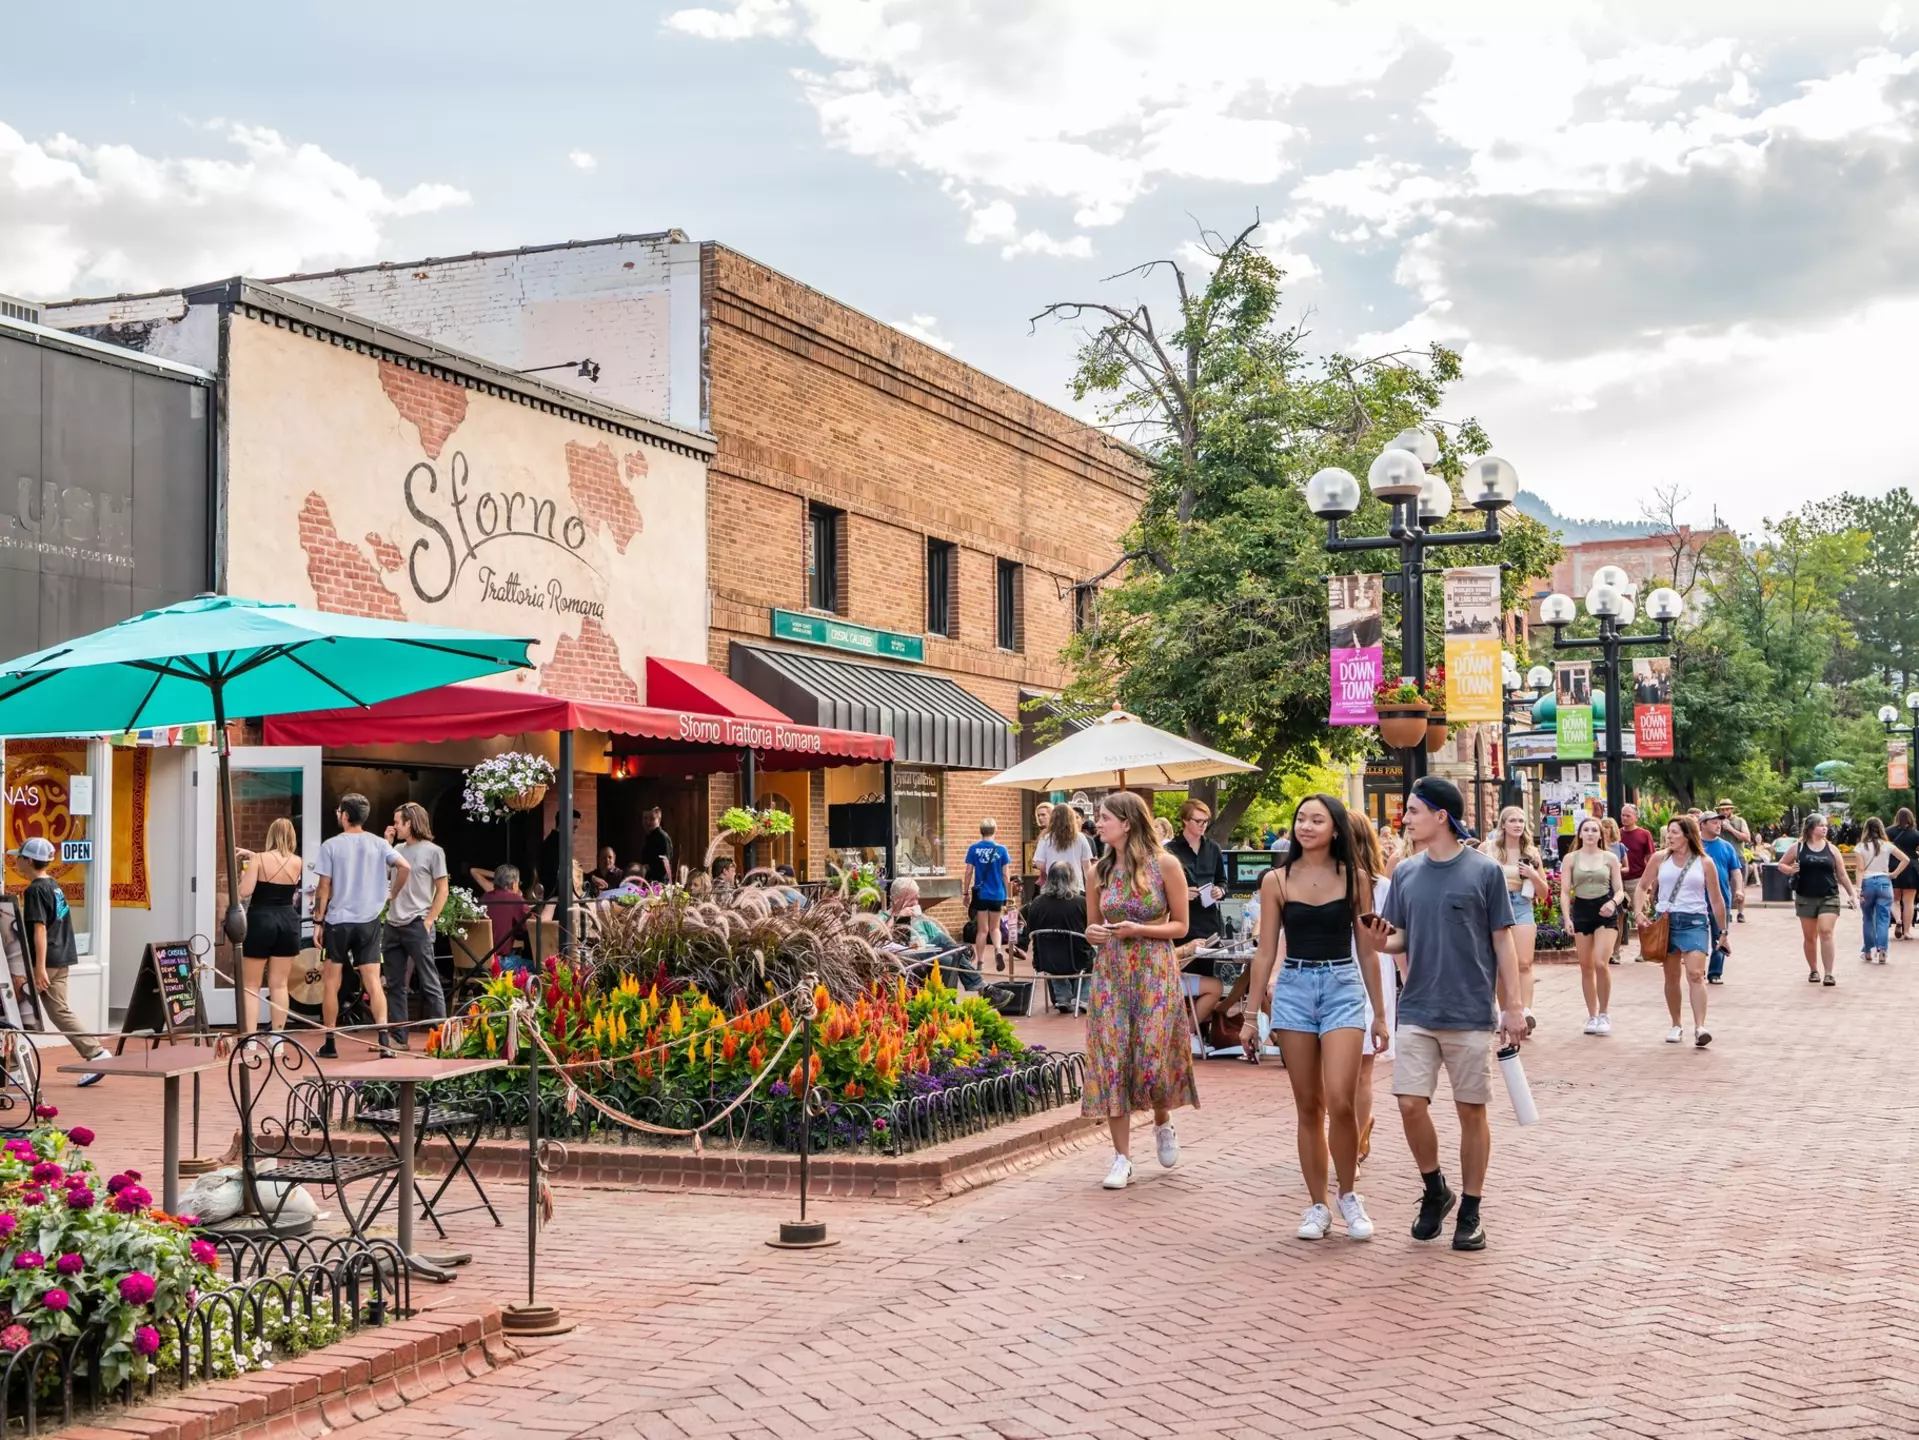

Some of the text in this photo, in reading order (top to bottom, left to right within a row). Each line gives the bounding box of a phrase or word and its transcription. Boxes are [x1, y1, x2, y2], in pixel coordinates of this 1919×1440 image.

[404, 450, 586, 604] Sforno
[478, 565, 605, 620] Trattoria Romana
[1340, 661, 1376, 681] DOWN
[1454, 655, 1494, 675] DOWN
[1340, 681, 1375, 701] TOWN
[1453, 675, 1494, 696] TOWN
[679, 713, 820, 750] Sforno Trattoria Romana
[1562, 717, 1587, 730] DOWN
[1640, 715, 1666, 728] DOWN
[1562, 730, 1588, 743] TOWN
[1641, 728, 1667, 741] TOWN
[1385, 767, 1403, 775] FAR
[63, 843, 91, 860] OPEN
